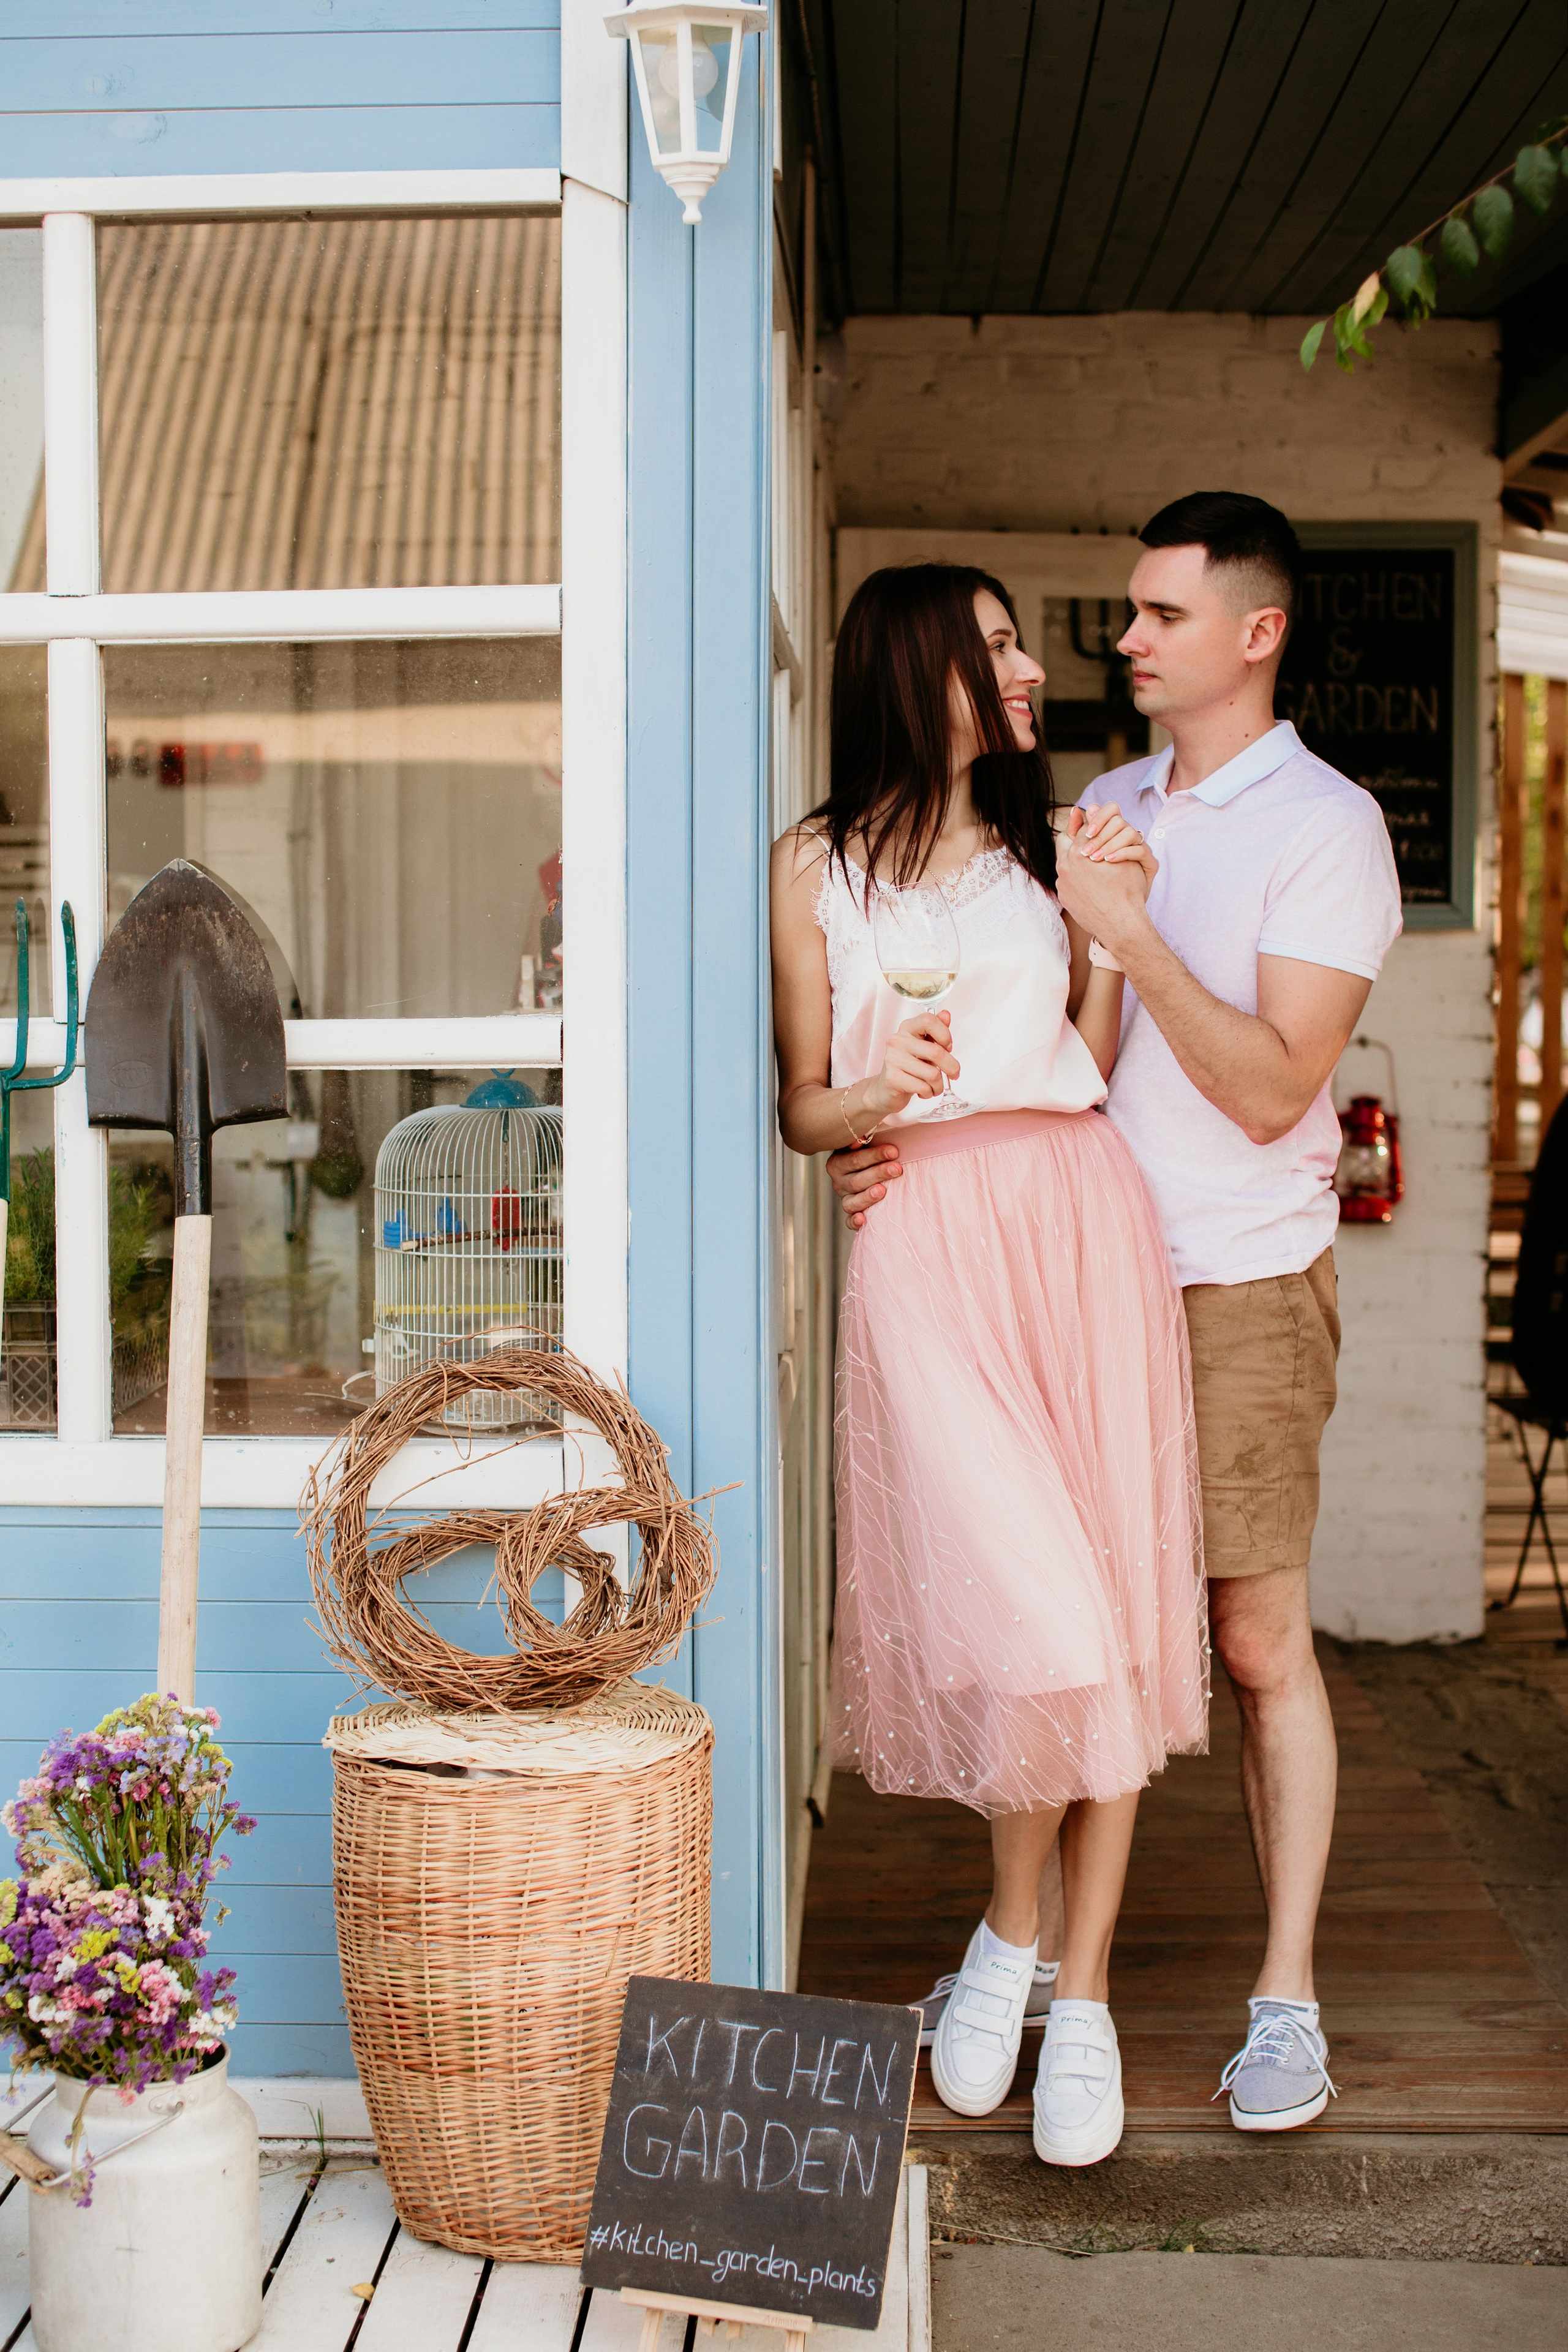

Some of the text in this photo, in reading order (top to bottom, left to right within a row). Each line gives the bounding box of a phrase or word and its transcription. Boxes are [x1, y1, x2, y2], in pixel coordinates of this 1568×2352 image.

[1296, 572, 1442, 621] ITCHEN
[1327, 625, 1365, 677] &
[645, 2015, 897, 2109] KITCHEN
[623, 2104, 881, 2198] GARDEN
[590, 2221, 876, 2298] #kitchen_garden_plants
